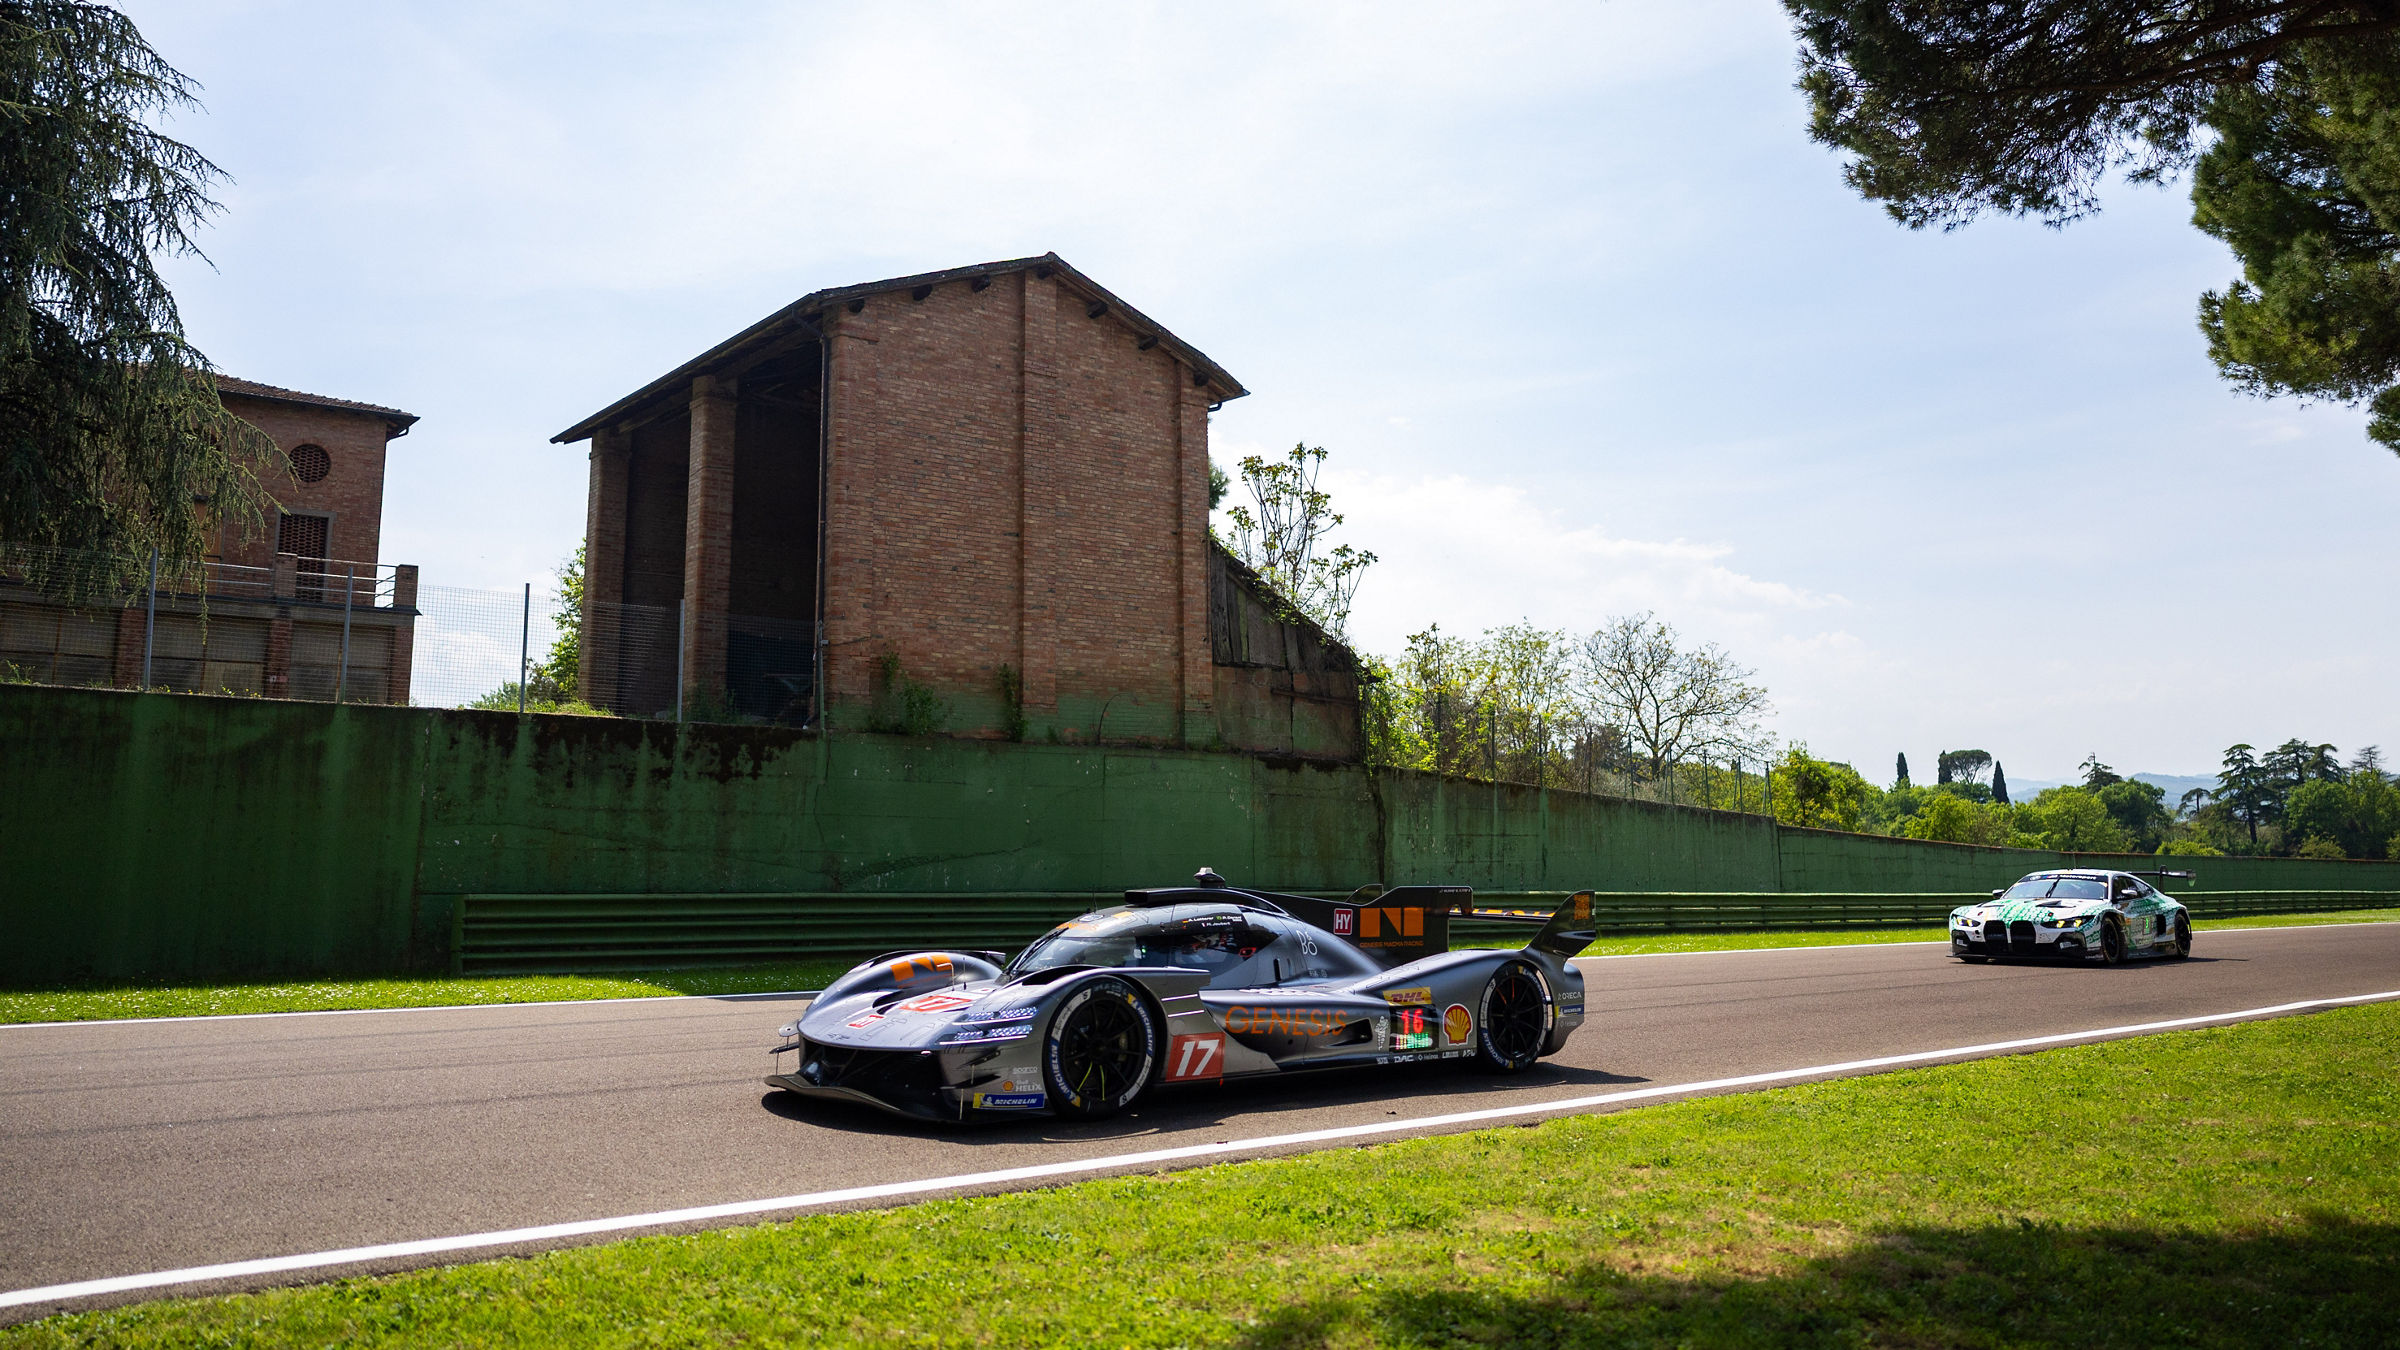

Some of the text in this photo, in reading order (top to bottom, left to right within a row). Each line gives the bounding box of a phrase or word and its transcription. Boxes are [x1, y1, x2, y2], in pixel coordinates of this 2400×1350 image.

[1335, 913, 1351, 930] HY
[1391, 991, 1424, 1003] DHL
[1561, 991, 1582, 1000] ORECA
[1137, 1007, 1154, 1053] MICHELIN
[1225, 1005, 1348, 1036] GENESIS
[1401, 1008, 1424, 1035] 16
[1051, 1044, 1071, 1094] MICHELIN
[1176, 1039, 1220, 1077] 17
[1016, 1084, 1043, 1092] HELIX
